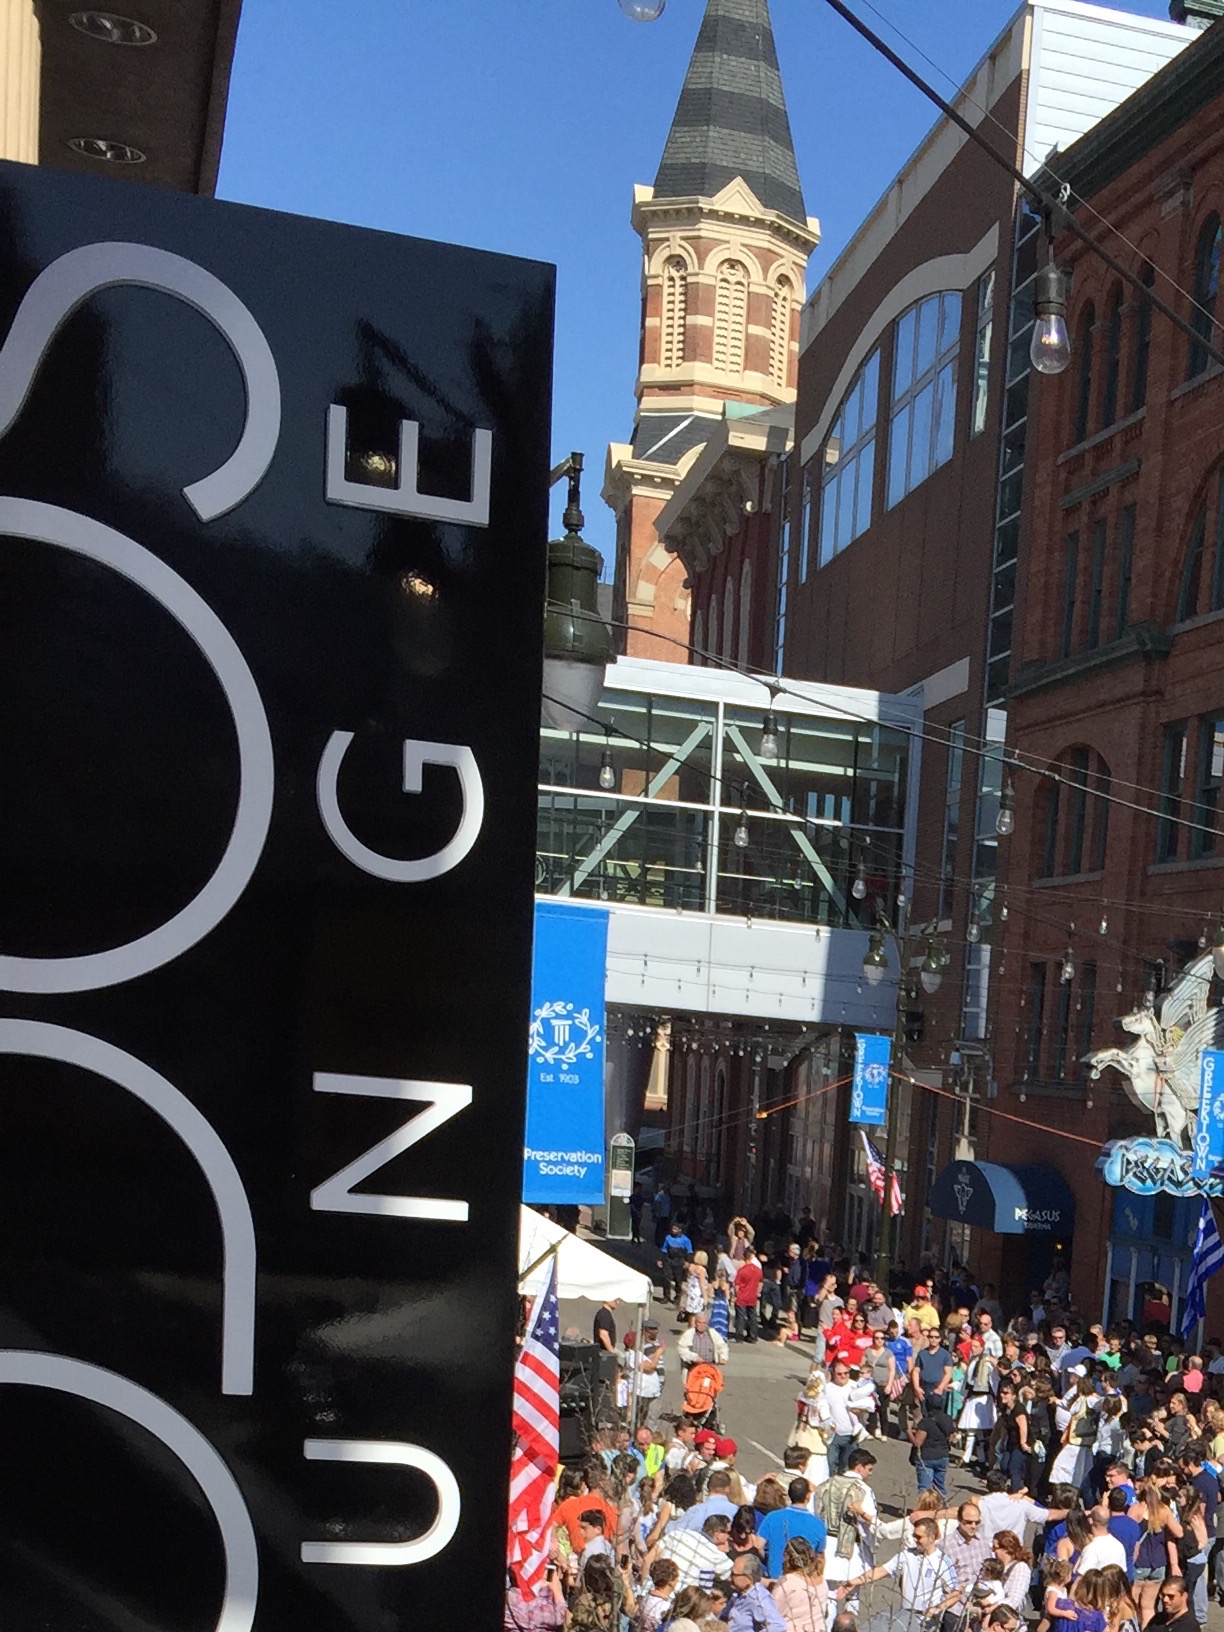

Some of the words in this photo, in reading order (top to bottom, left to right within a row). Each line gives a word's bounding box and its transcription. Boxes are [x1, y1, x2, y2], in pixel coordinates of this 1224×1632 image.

[559, 1072, 580, 1084] 1903
[524, 1148, 602, 1165] Preservation
[539, 1162, 588, 1179] Society
[1014, 1206, 1061, 1222] PEGASUS
